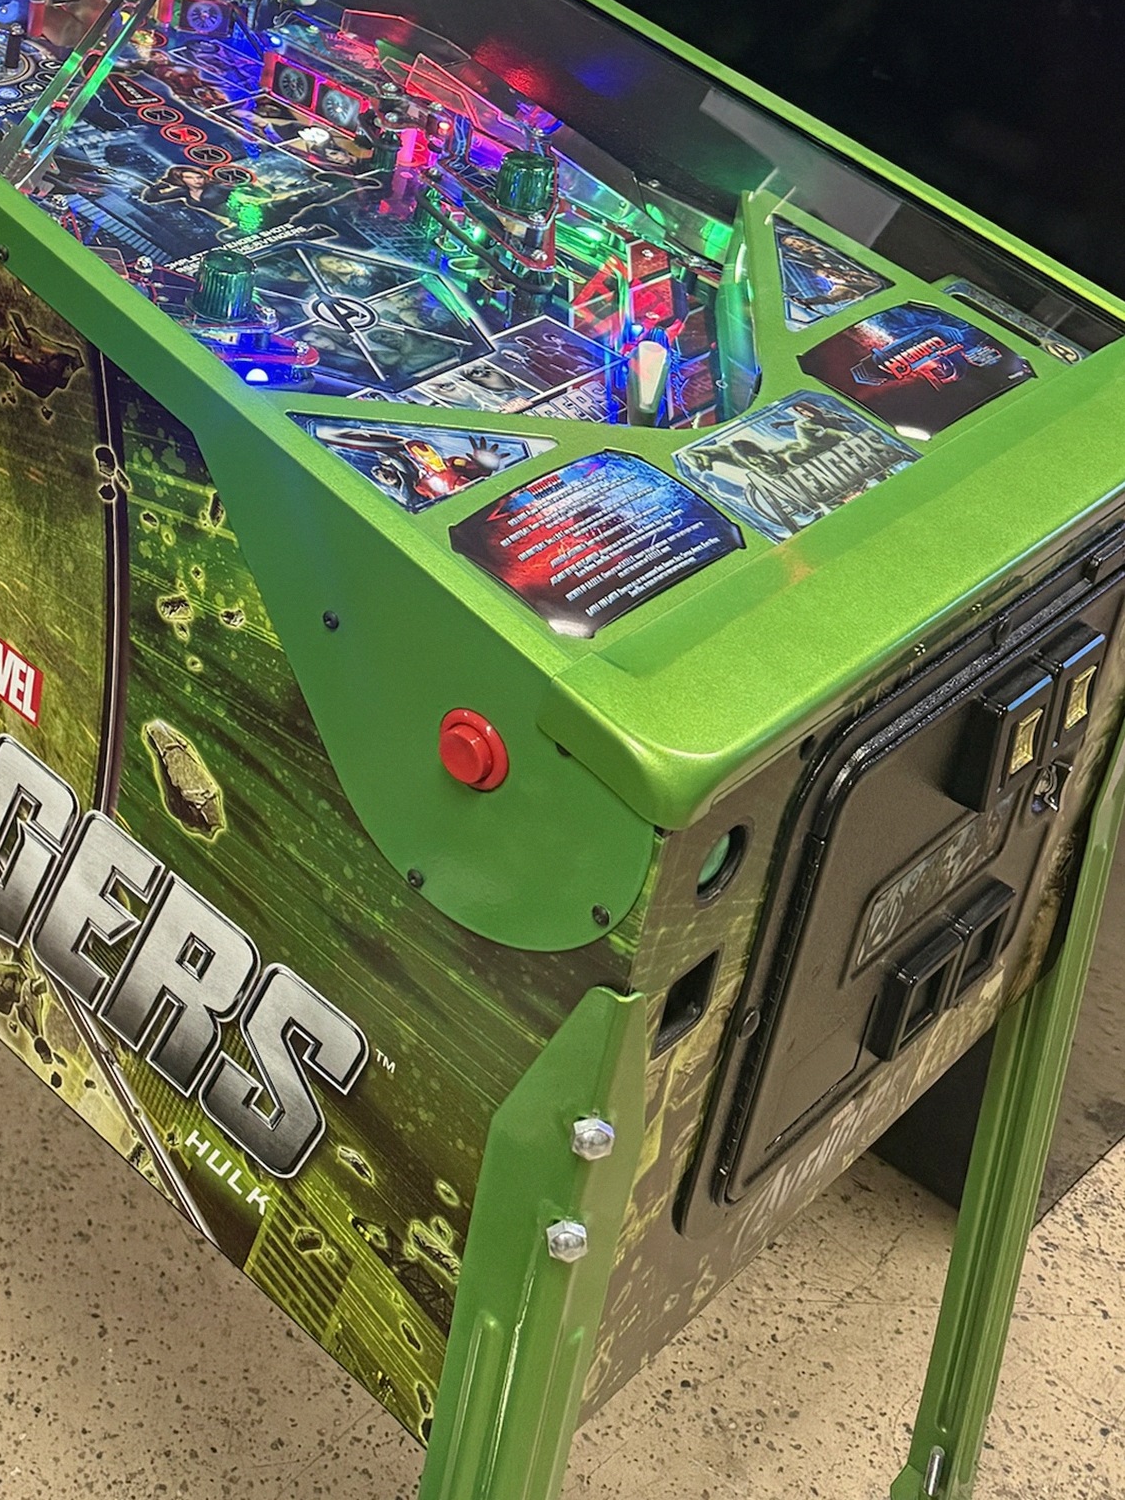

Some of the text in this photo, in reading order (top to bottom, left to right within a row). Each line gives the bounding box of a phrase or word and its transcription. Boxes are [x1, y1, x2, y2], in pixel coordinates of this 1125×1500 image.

[744, 428, 906, 536] AVENGERS
[375, 1049, 398, 1074] TM
[183, 1128, 273, 1218] HULK
